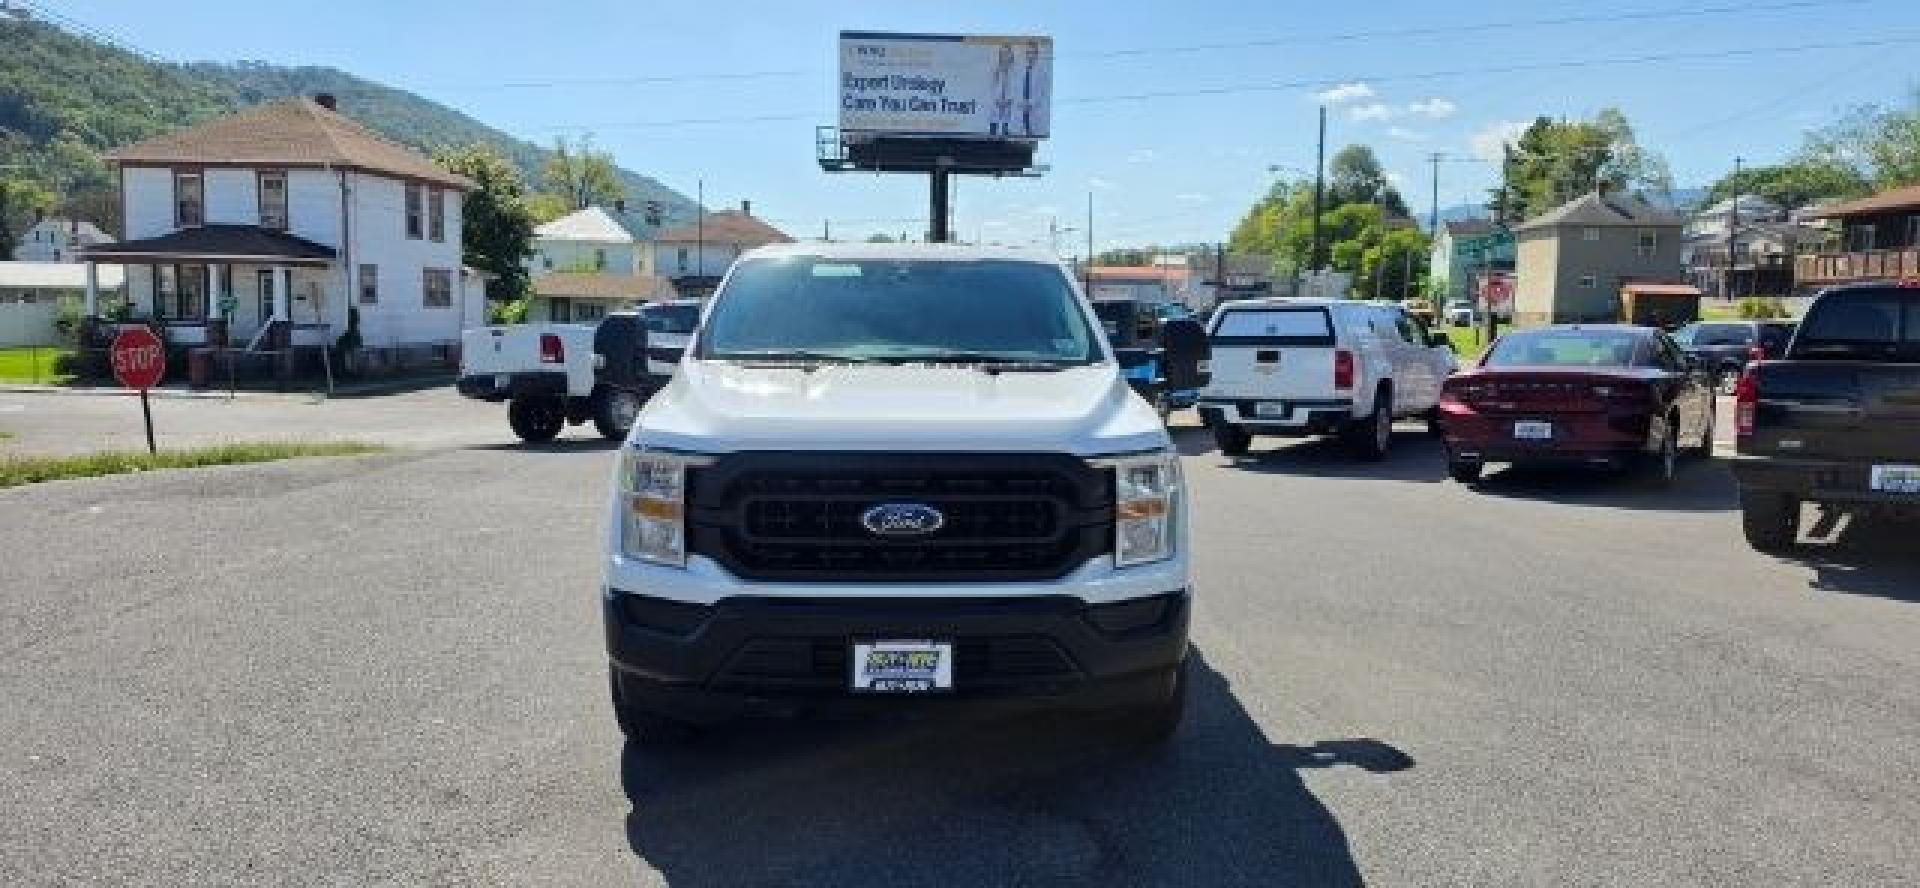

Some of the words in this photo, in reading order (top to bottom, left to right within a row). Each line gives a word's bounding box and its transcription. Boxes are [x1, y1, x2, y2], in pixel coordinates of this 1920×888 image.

[843, 73, 888, 93] Expert
[891, 75, 945, 94] Urology
[842, 94, 877, 111] Care
[879, 96, 906, 112] You
[909, 96, 937, 112] Can
[940, 98, 976, 114] Trust
[116, 345, 160, 372] STOP
[879, 511, 926, 530] Ford
